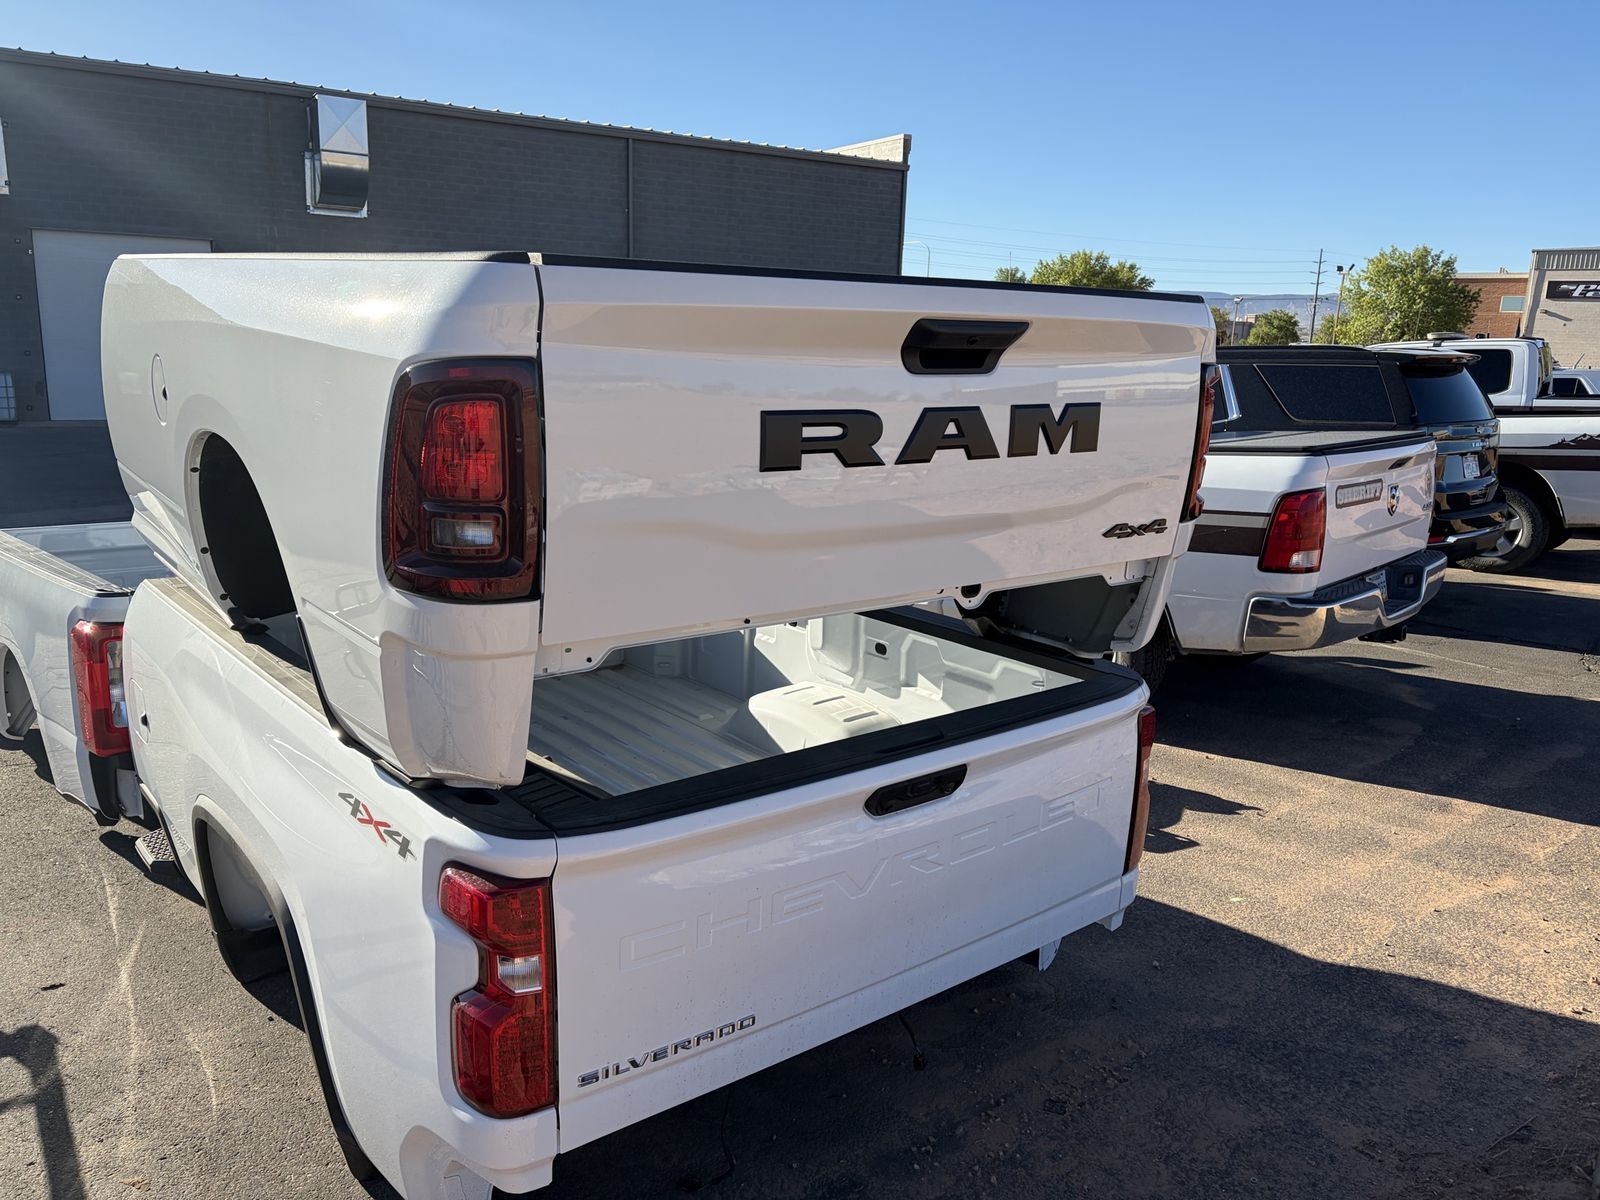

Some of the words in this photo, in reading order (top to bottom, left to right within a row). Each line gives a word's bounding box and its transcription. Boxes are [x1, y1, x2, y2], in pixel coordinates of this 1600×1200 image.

[759, 402, 1101, 472] RAM
[338, 792, 417, 862] 4X4
[618, 775, 1113, 973] CHEVROLET
[577, 1014, 756, 1088] SILVERADO
